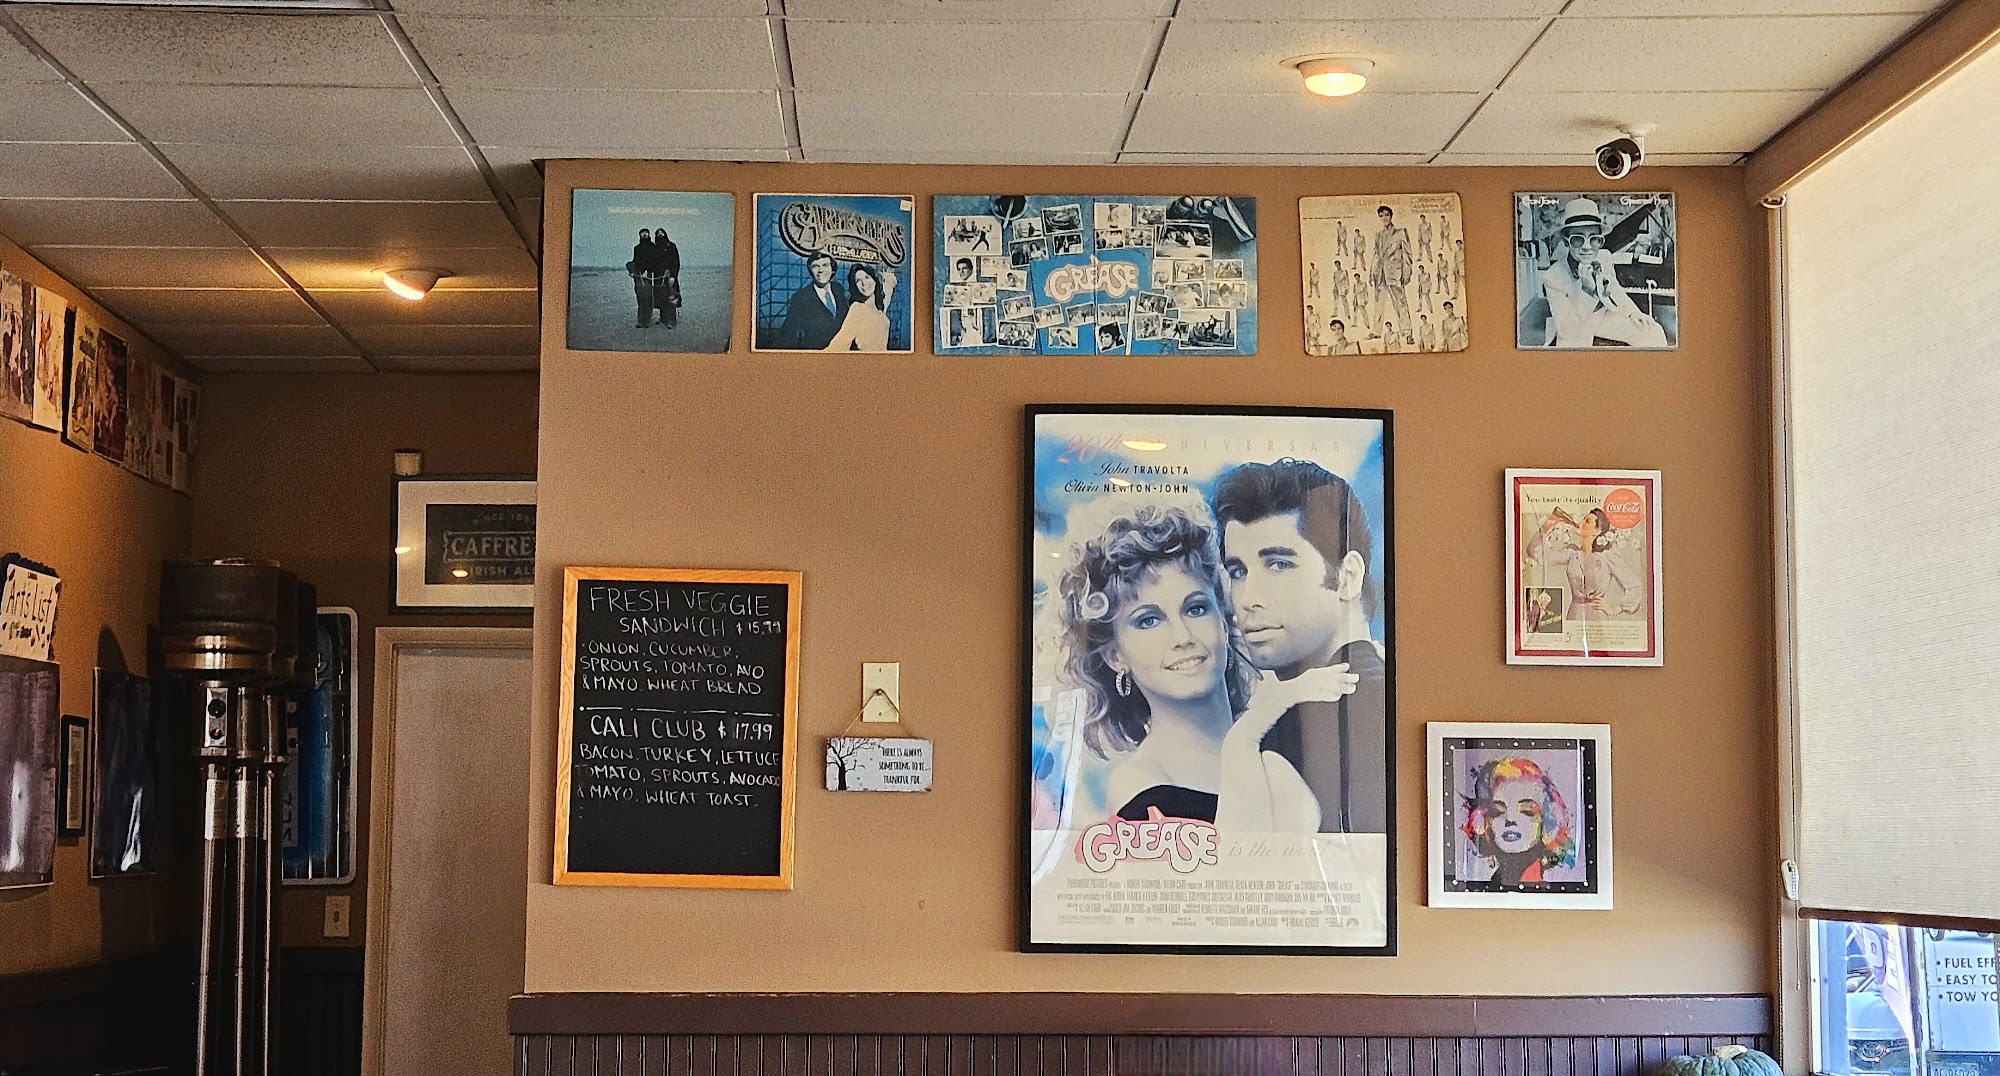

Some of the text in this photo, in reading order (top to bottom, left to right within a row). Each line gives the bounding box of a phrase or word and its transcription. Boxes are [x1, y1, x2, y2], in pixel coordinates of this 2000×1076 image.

[1045, 263, 1139, 302] GREASE
[1094, 461, 1189, 476] John TRAVOLTA
[1064, 479, 1189, 494] Olivia NEWTON-JOHN
[1574, 494, 1602, 505] quality
[451, 536, 536, 557] CAFFRE
[590, 586, 770, 617] FRESH VEGGIE
[619, 616, 726, 637] SANDWICH
[736, 663, 765, 679] AVO
[647, 678, 699, 692] WHEAT
[707, 679, 762, 695] BREAD
[590, 714, 639, 738] CALI
[651, 717, 706, 742] CLUB
[735, 722, 773, 742] 17.99
[721, 750, 780, 766] LETTUCE
[729, 771, 781, 787] AVOCADO
[645, 789, 698, 804] WHEAT
[1082, 821, 1218, 874] GREASE
[1945, 957, 1973, 969] FUEL
[1946, 974, 1977, 985] EASY
[1946, 991, 1977, 1002] TOW
